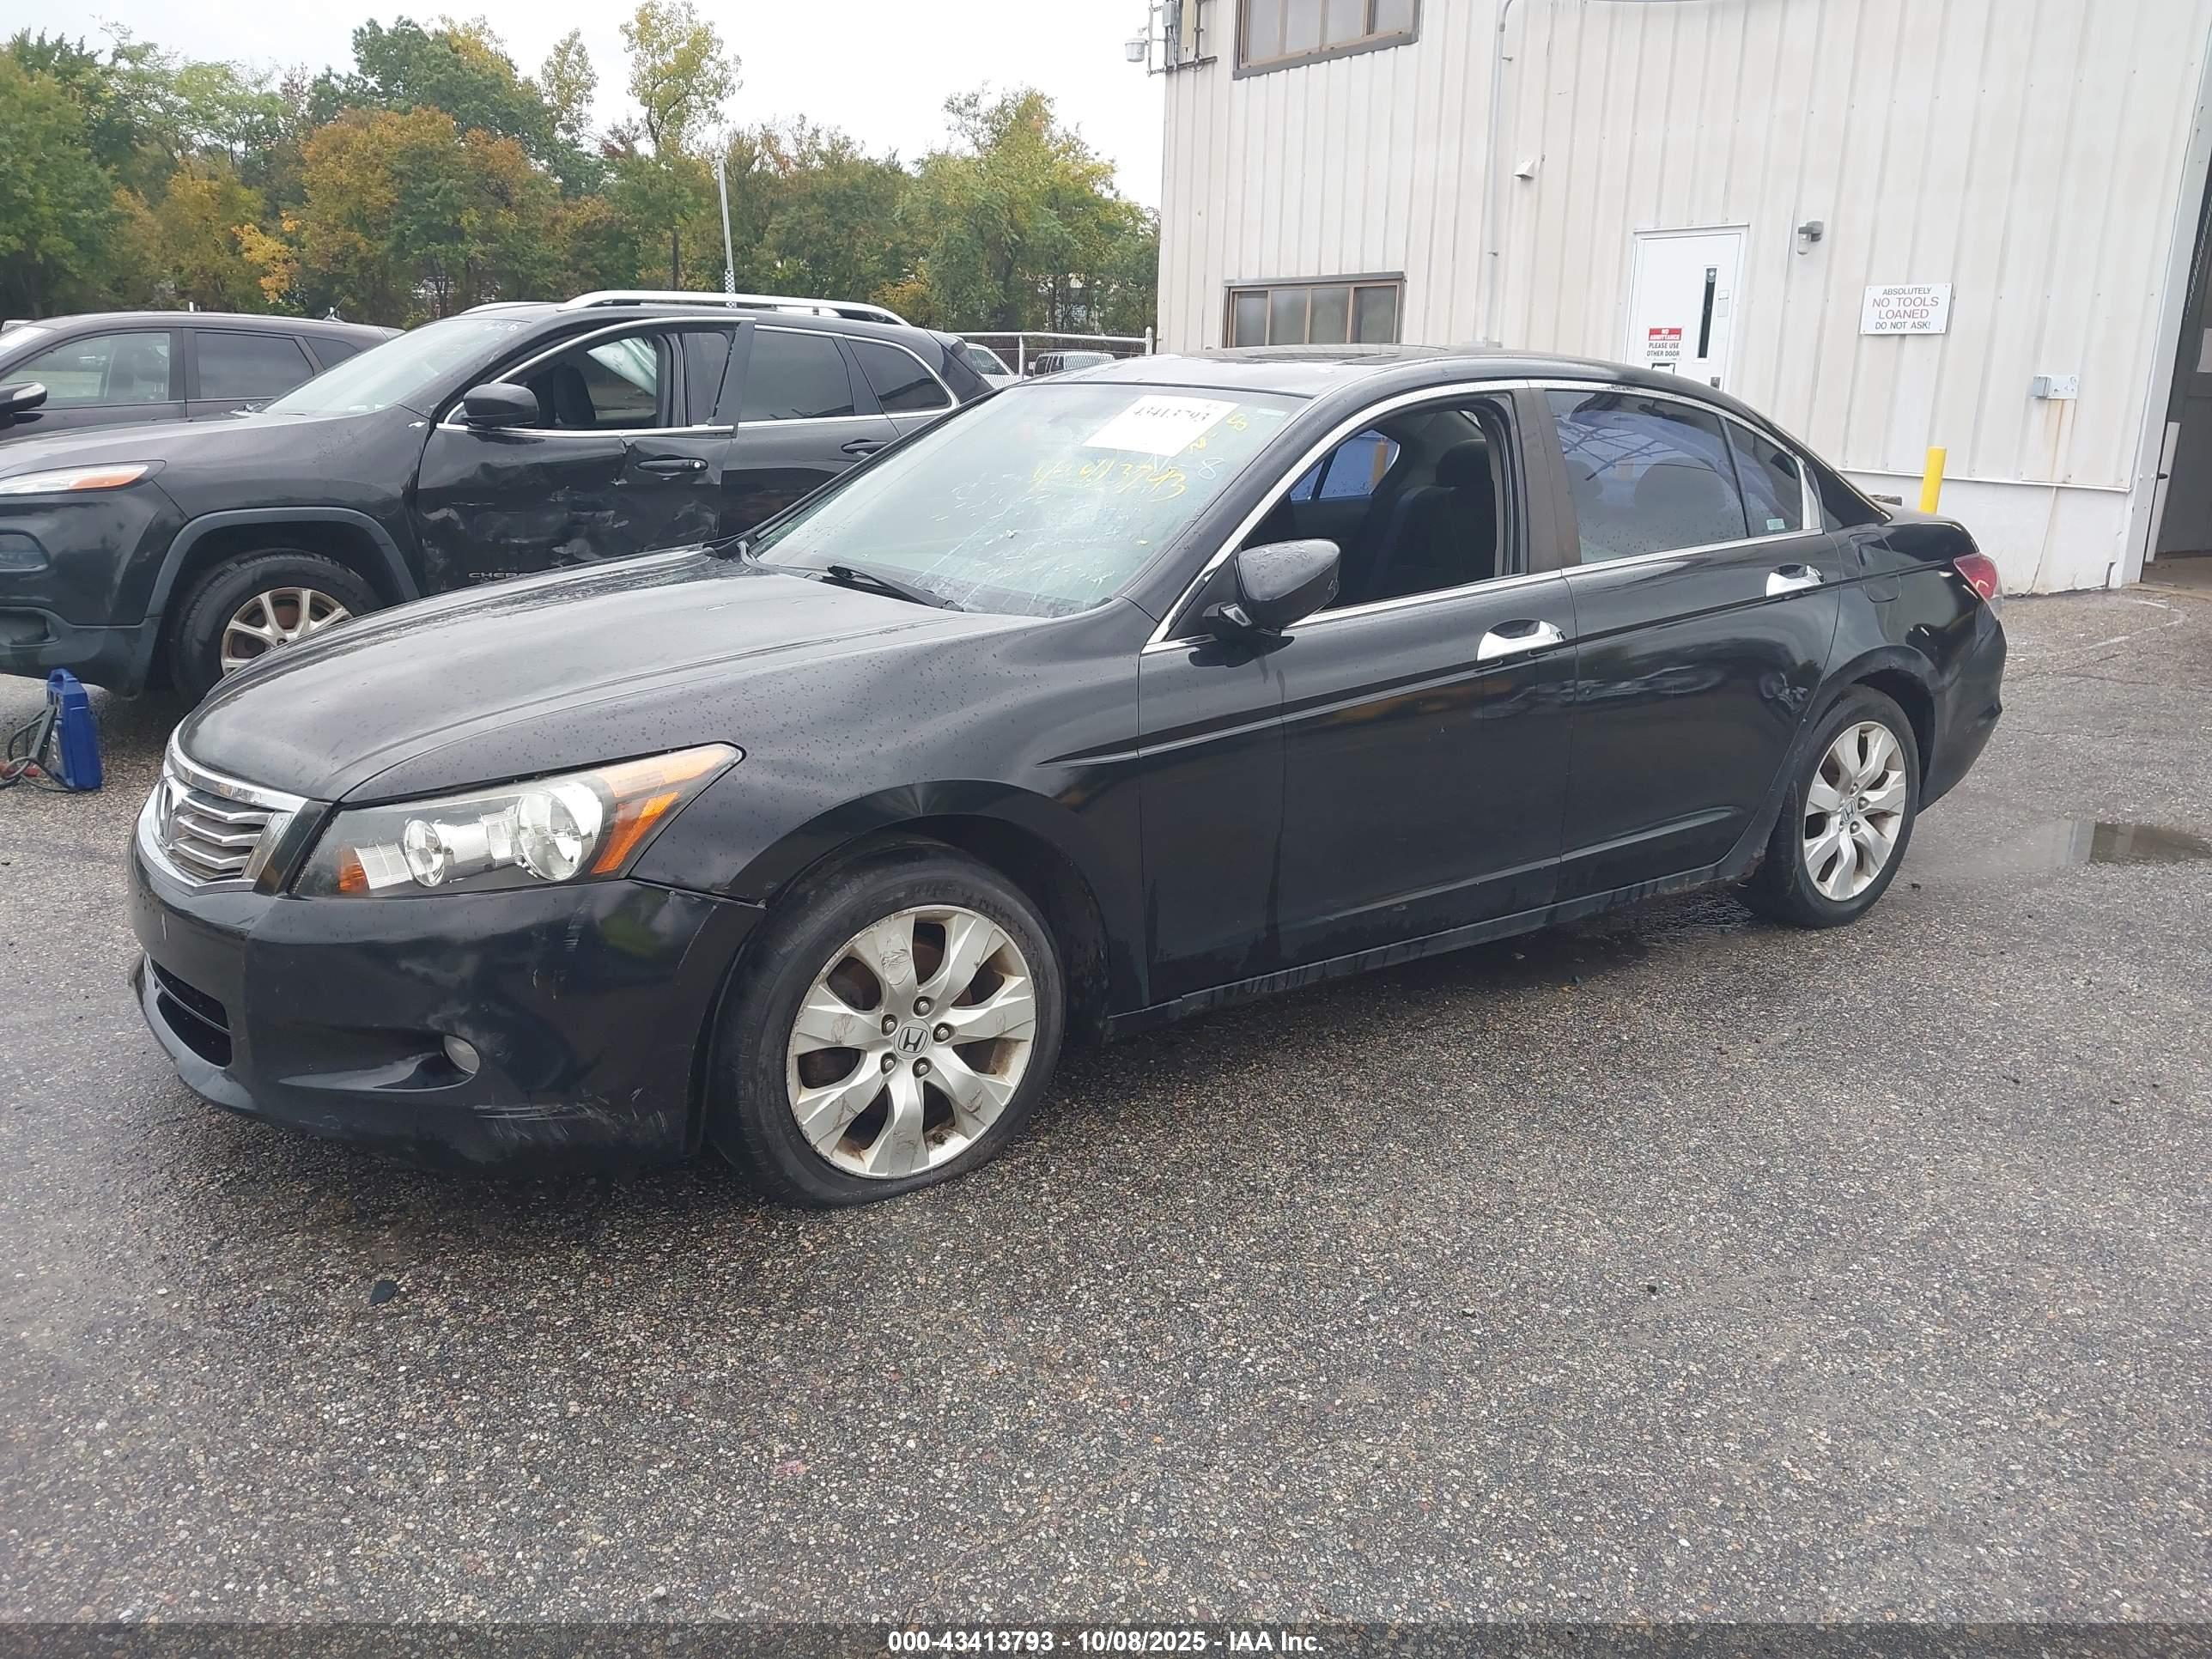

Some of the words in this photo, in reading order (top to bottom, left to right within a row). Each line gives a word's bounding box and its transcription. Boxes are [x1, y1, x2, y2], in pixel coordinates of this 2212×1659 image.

[1882, 287, 1932, 295] ABSOLUTELY
[1872, 297, 1890, 307] NO
[1896, 296, 1939, 307] TOOLS
[1878, 309, 1929, 319] LOANED
[1875, 321, 1887, 330] DO
[1890, 321, 1908, 330] NOT
[1911, 321, 1931, 330] ASK!
